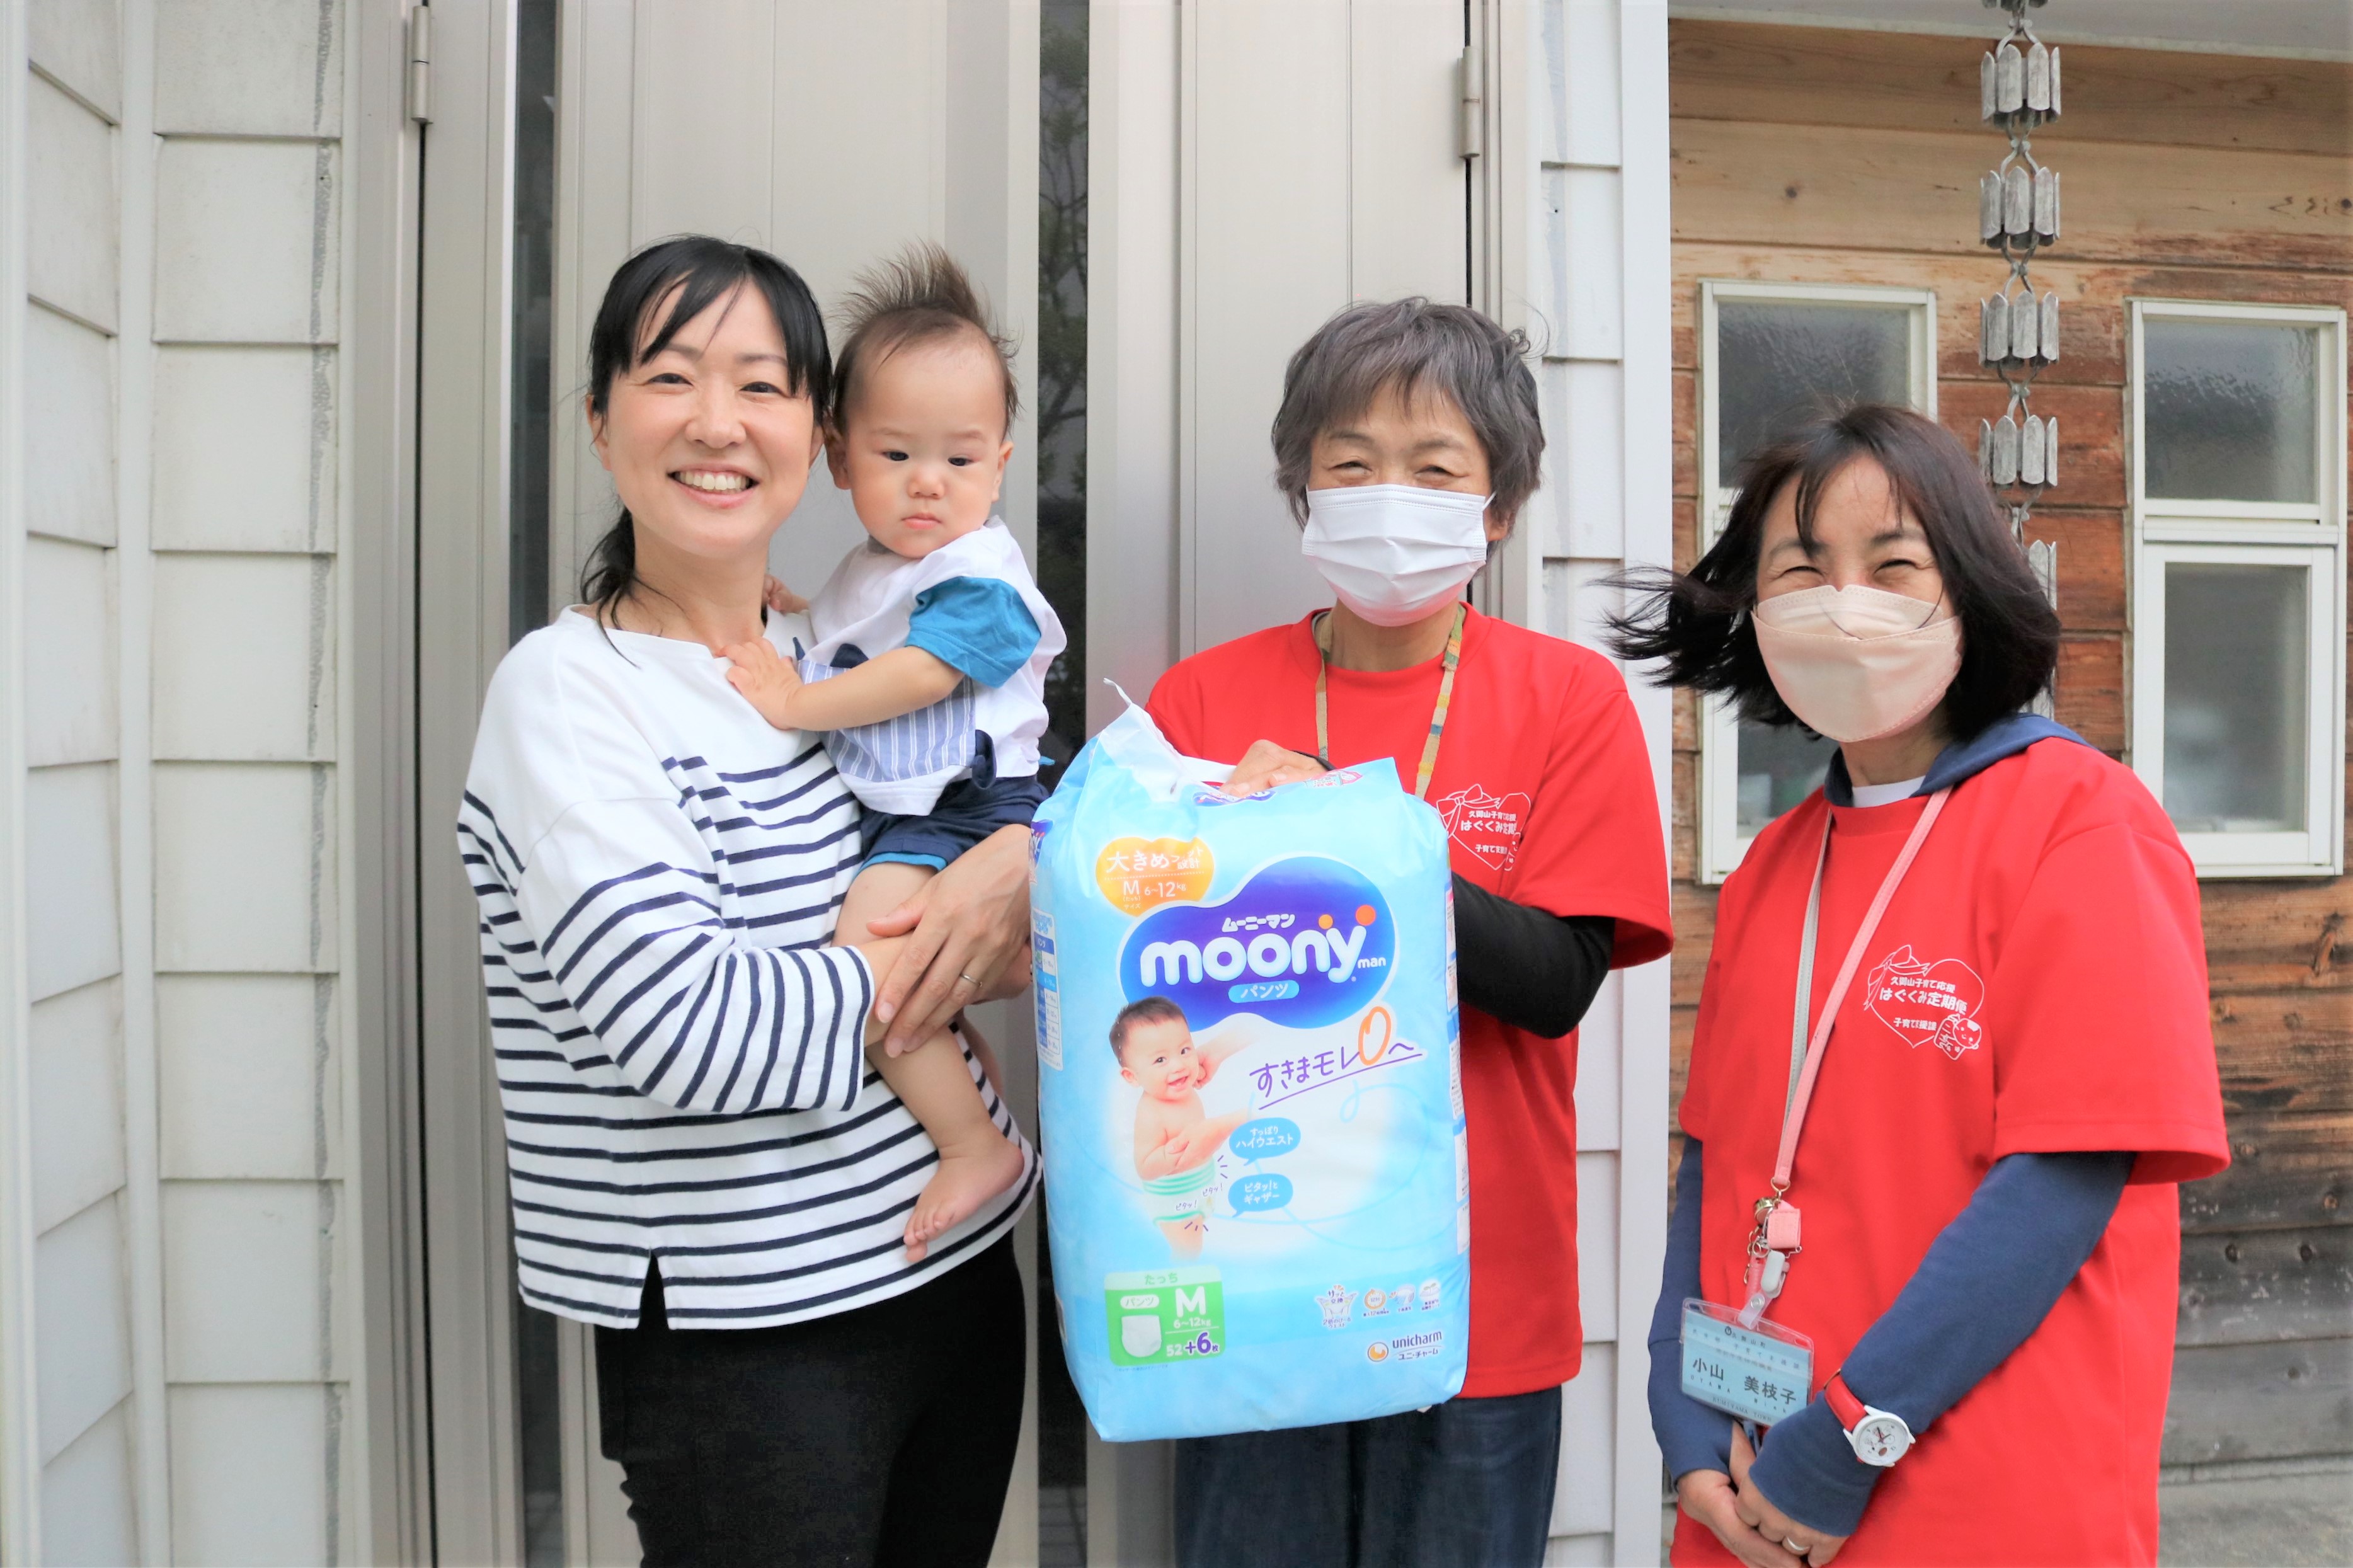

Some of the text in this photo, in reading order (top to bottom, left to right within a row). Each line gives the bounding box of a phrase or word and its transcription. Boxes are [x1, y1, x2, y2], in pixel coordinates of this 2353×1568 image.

[1106, 850, 1171, 873] 大きめ
[1123, 880, 1140, 895] M
[1222, 913, 1295, 933] ムーニーマン
[1140, 924, 1386, 987] moony man
[1240, 983, 1288, 998] パンツ
[1891, 976, 1955, 993] 久御山子育て応援
[1879, 987, 1968, 1015] はぐくみ定期便
[1250, 1126, 1279, 1136] すっぽり
[1235, 1133, 1293, 1148] ハイウエスト
[1244, 1192, 1280, 1205] ギャザー
[1144, 1273, 1178, 1285] たっち
[1125, 1297, 1154, 1307] パンツ
[1175, 1286, 1206, 1318] M
[1392, 1331, 1442, 1349] unicharm
[1398, 1348, 1438, 1361] ユニ・チャーム
[1693, 1358, 1724, 1381] 小山
[1744, 1375, 1796, 1405] 美枝子
